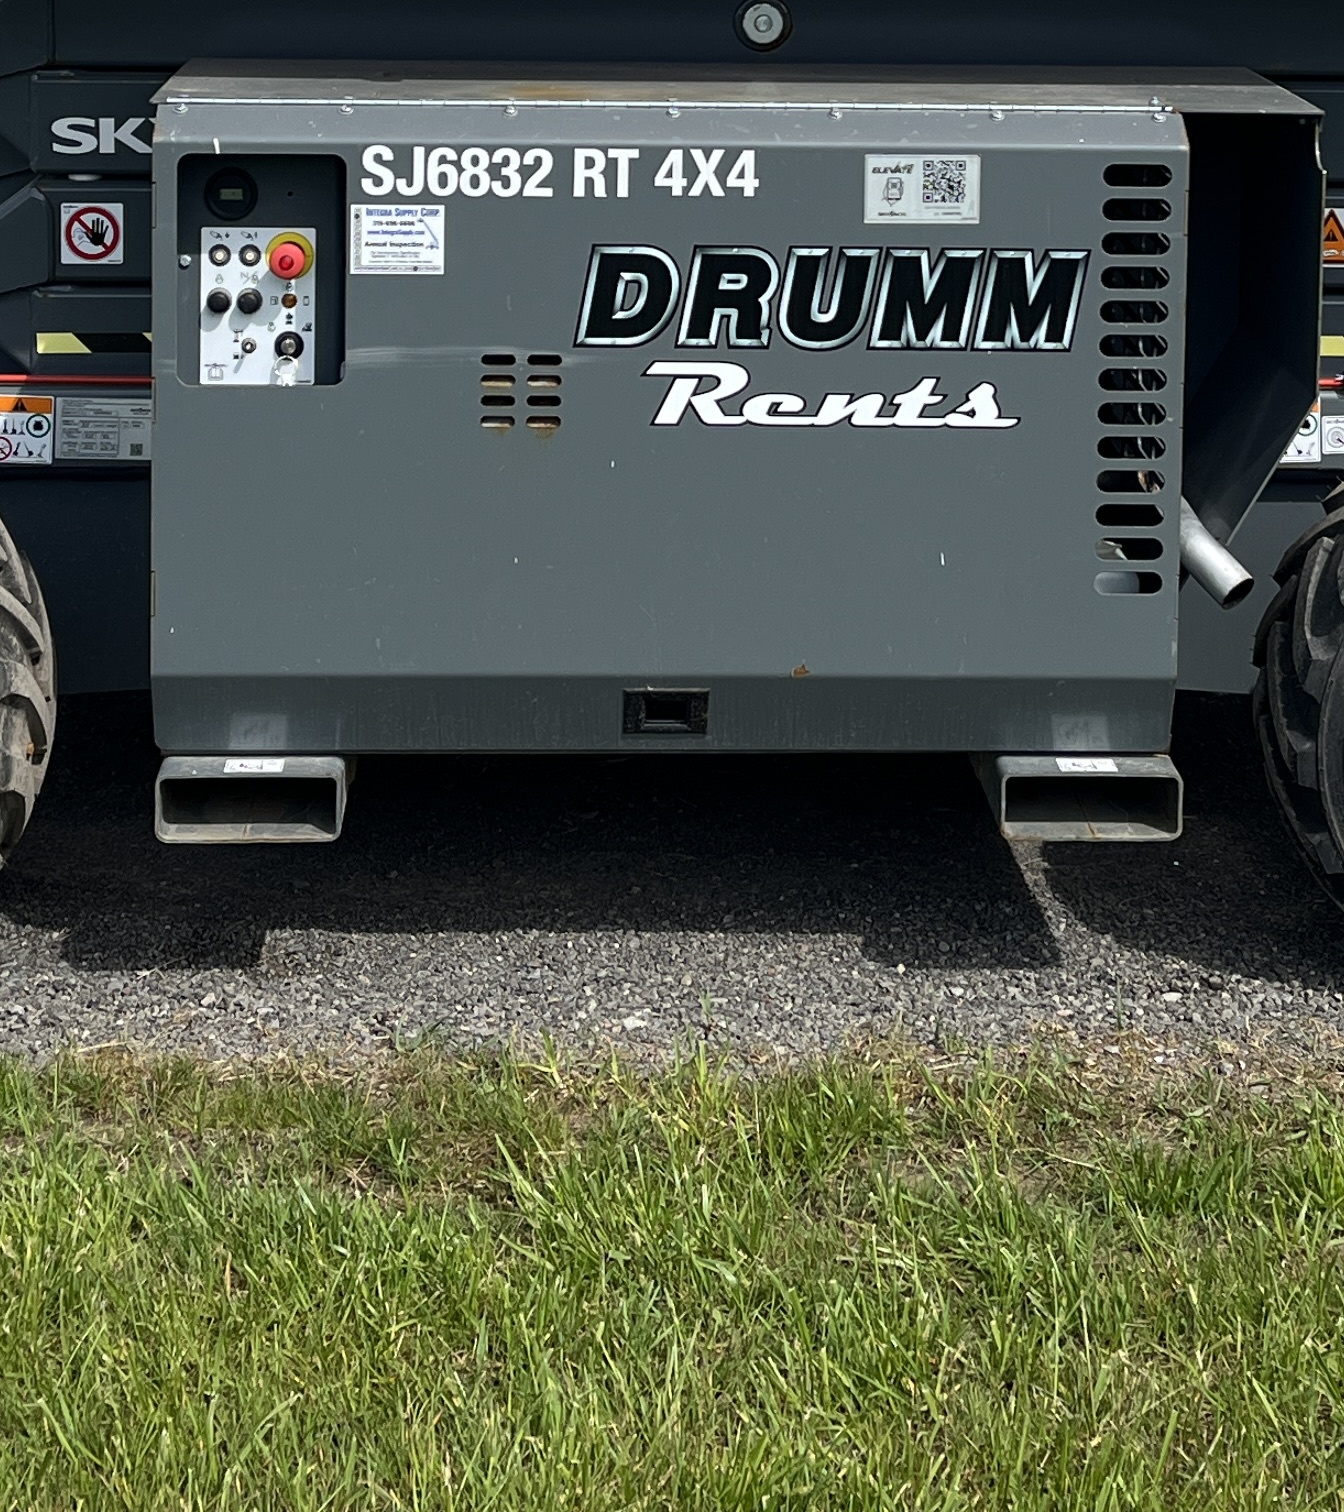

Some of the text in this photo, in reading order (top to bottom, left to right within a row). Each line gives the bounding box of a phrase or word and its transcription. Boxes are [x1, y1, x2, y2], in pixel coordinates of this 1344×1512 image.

[50, 117, 152, 154] SK
[360, 145, 760, 197] SJ6832 RT 4X4
[573, 244, 1092, 352] DRUMM
[640, 359, 1022, 428] Rents
